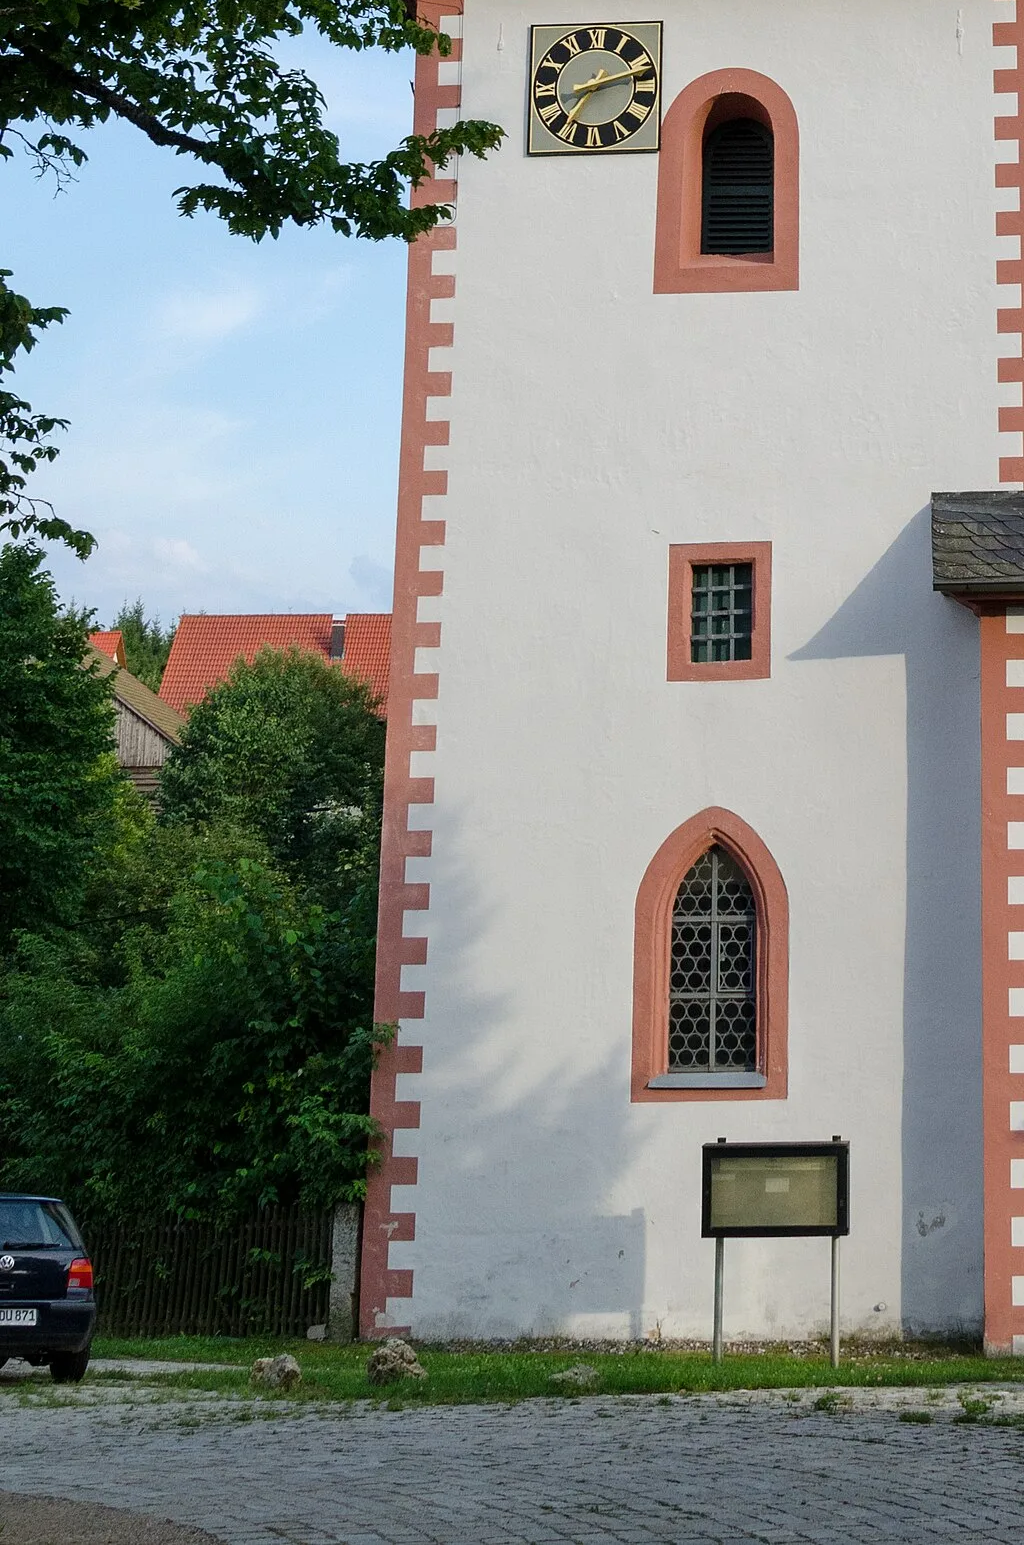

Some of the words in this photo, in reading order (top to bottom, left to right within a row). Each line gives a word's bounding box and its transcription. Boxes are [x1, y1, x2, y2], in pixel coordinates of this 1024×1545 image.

[560, 34, 582, 57] XI
[587, 29, 607, 49] XII
[614, 34, 631, 54] I
[541, 54, 564, 74] X
[536, 80, 555, 99] IX
[635, 77, 656, 94] III
[539, 102, 562, 127] VIII
[626, 100, 651, 123] IIII
[556, 121, 578, 143] VII
[584, 127, 603, 147] VI
[613, 120, 632, 141] V
[15, 1309, 35, 1321] 871
